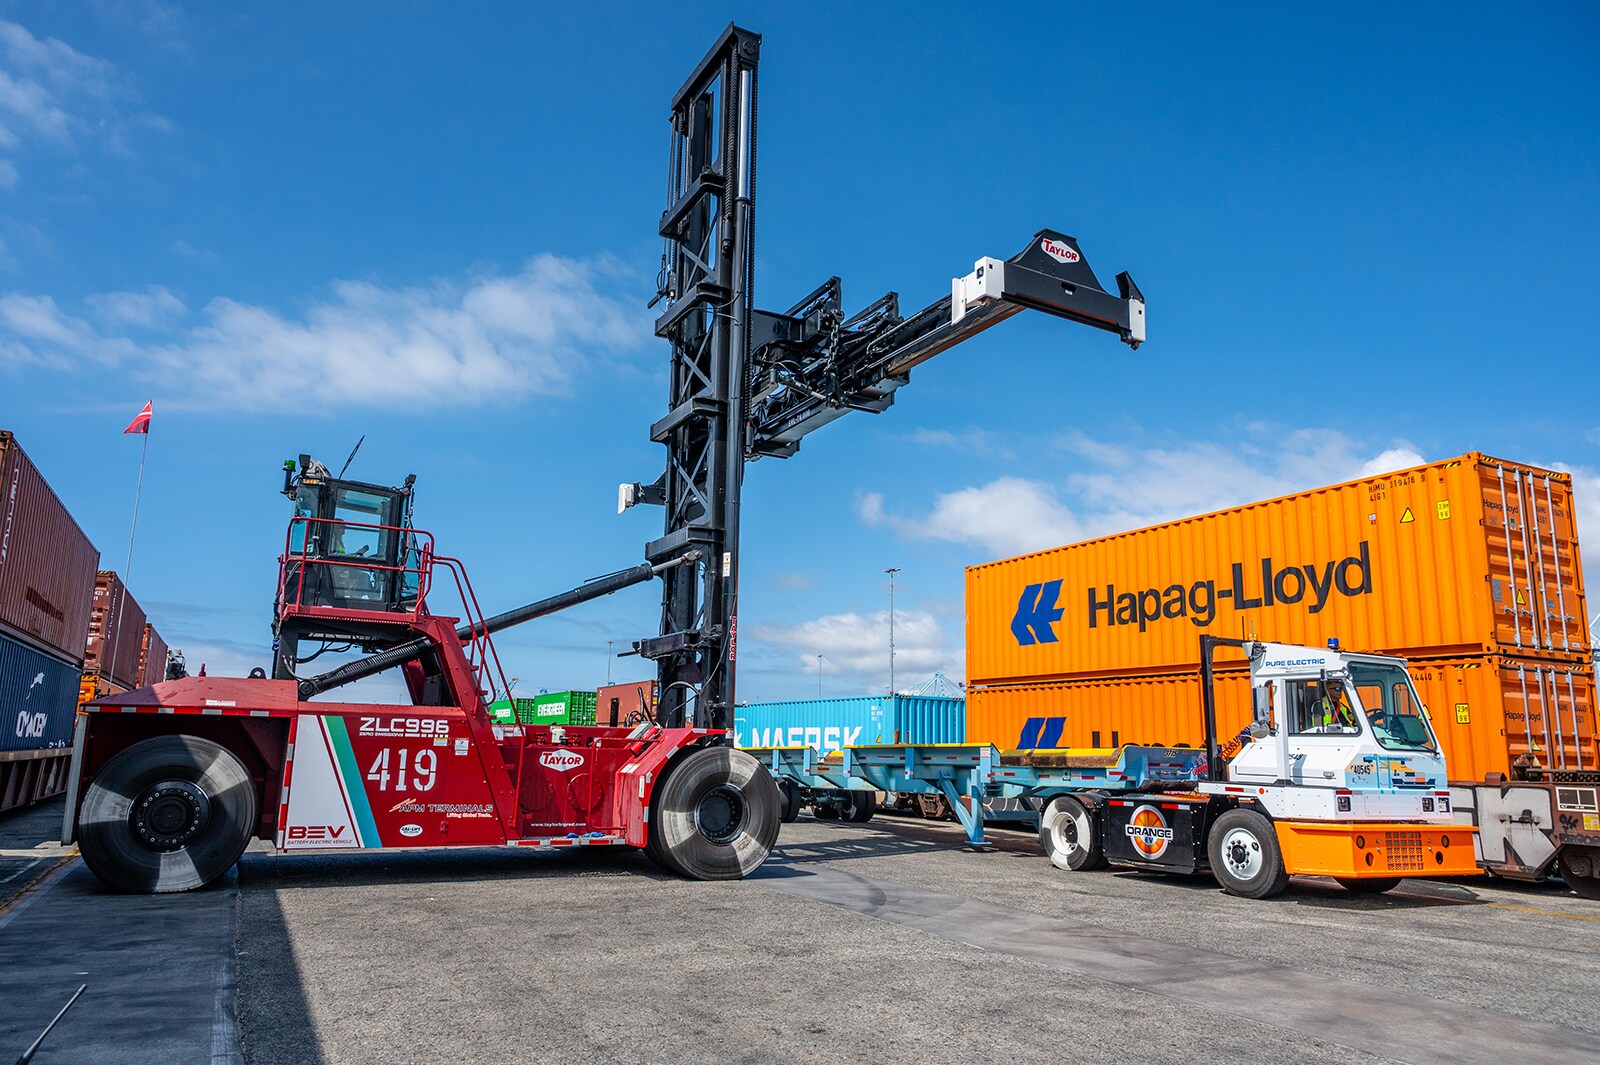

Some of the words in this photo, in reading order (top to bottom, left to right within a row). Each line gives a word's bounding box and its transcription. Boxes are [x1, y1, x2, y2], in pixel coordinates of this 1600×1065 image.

[1043, 239, 1078, 262] TAYLOR
[1088, 541, 1373, 633] Hapag-Lloyd
[729, 615, 738, 662] TAYLOR
[1286, 658, 1326, 666] ELECTRIC
[359, 717, 450, 733] ZLC996
[752, 726, 864, 756] MAERSK
[542, 751, 582, 766] TAYLOR
[367, 748, 438, 792] 419
[399, 803, 425, 813] APM
[428, 803, 494, 813] TERMINALS
[287, 825, 346, 840] BEV
[1126, 826, 1172, 839] ORANGE
[1144, 836, 1154, 844] EV
